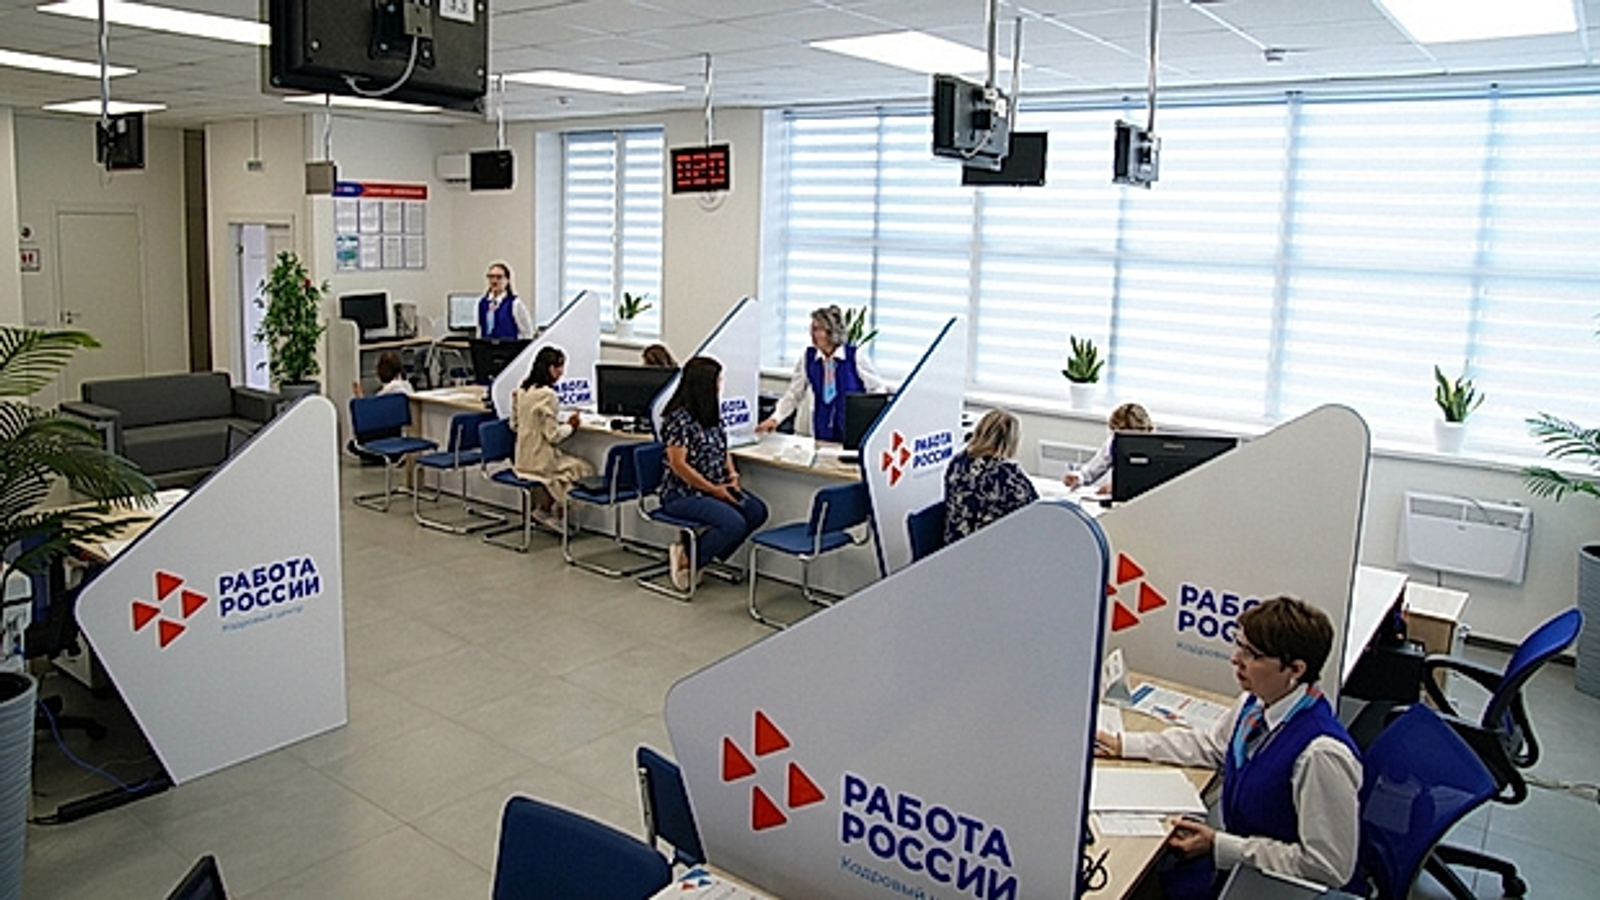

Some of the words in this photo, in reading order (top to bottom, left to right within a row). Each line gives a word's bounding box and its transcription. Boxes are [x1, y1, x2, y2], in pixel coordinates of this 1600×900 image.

[913, 447, 953, 468] РОССИИ
[914, 432, 952, 452] РАБОТА
[219, 557, 316, 595] РАБОТА
[220, 576, 320, 617] РОССИИ
[1178, 610, 1239, 643] РОС
[844, 774, 1012, 867] РАБОТА
[841, 811, 1018, 900] РОССИИ
[840, 855, 926, 900] Кадровый
